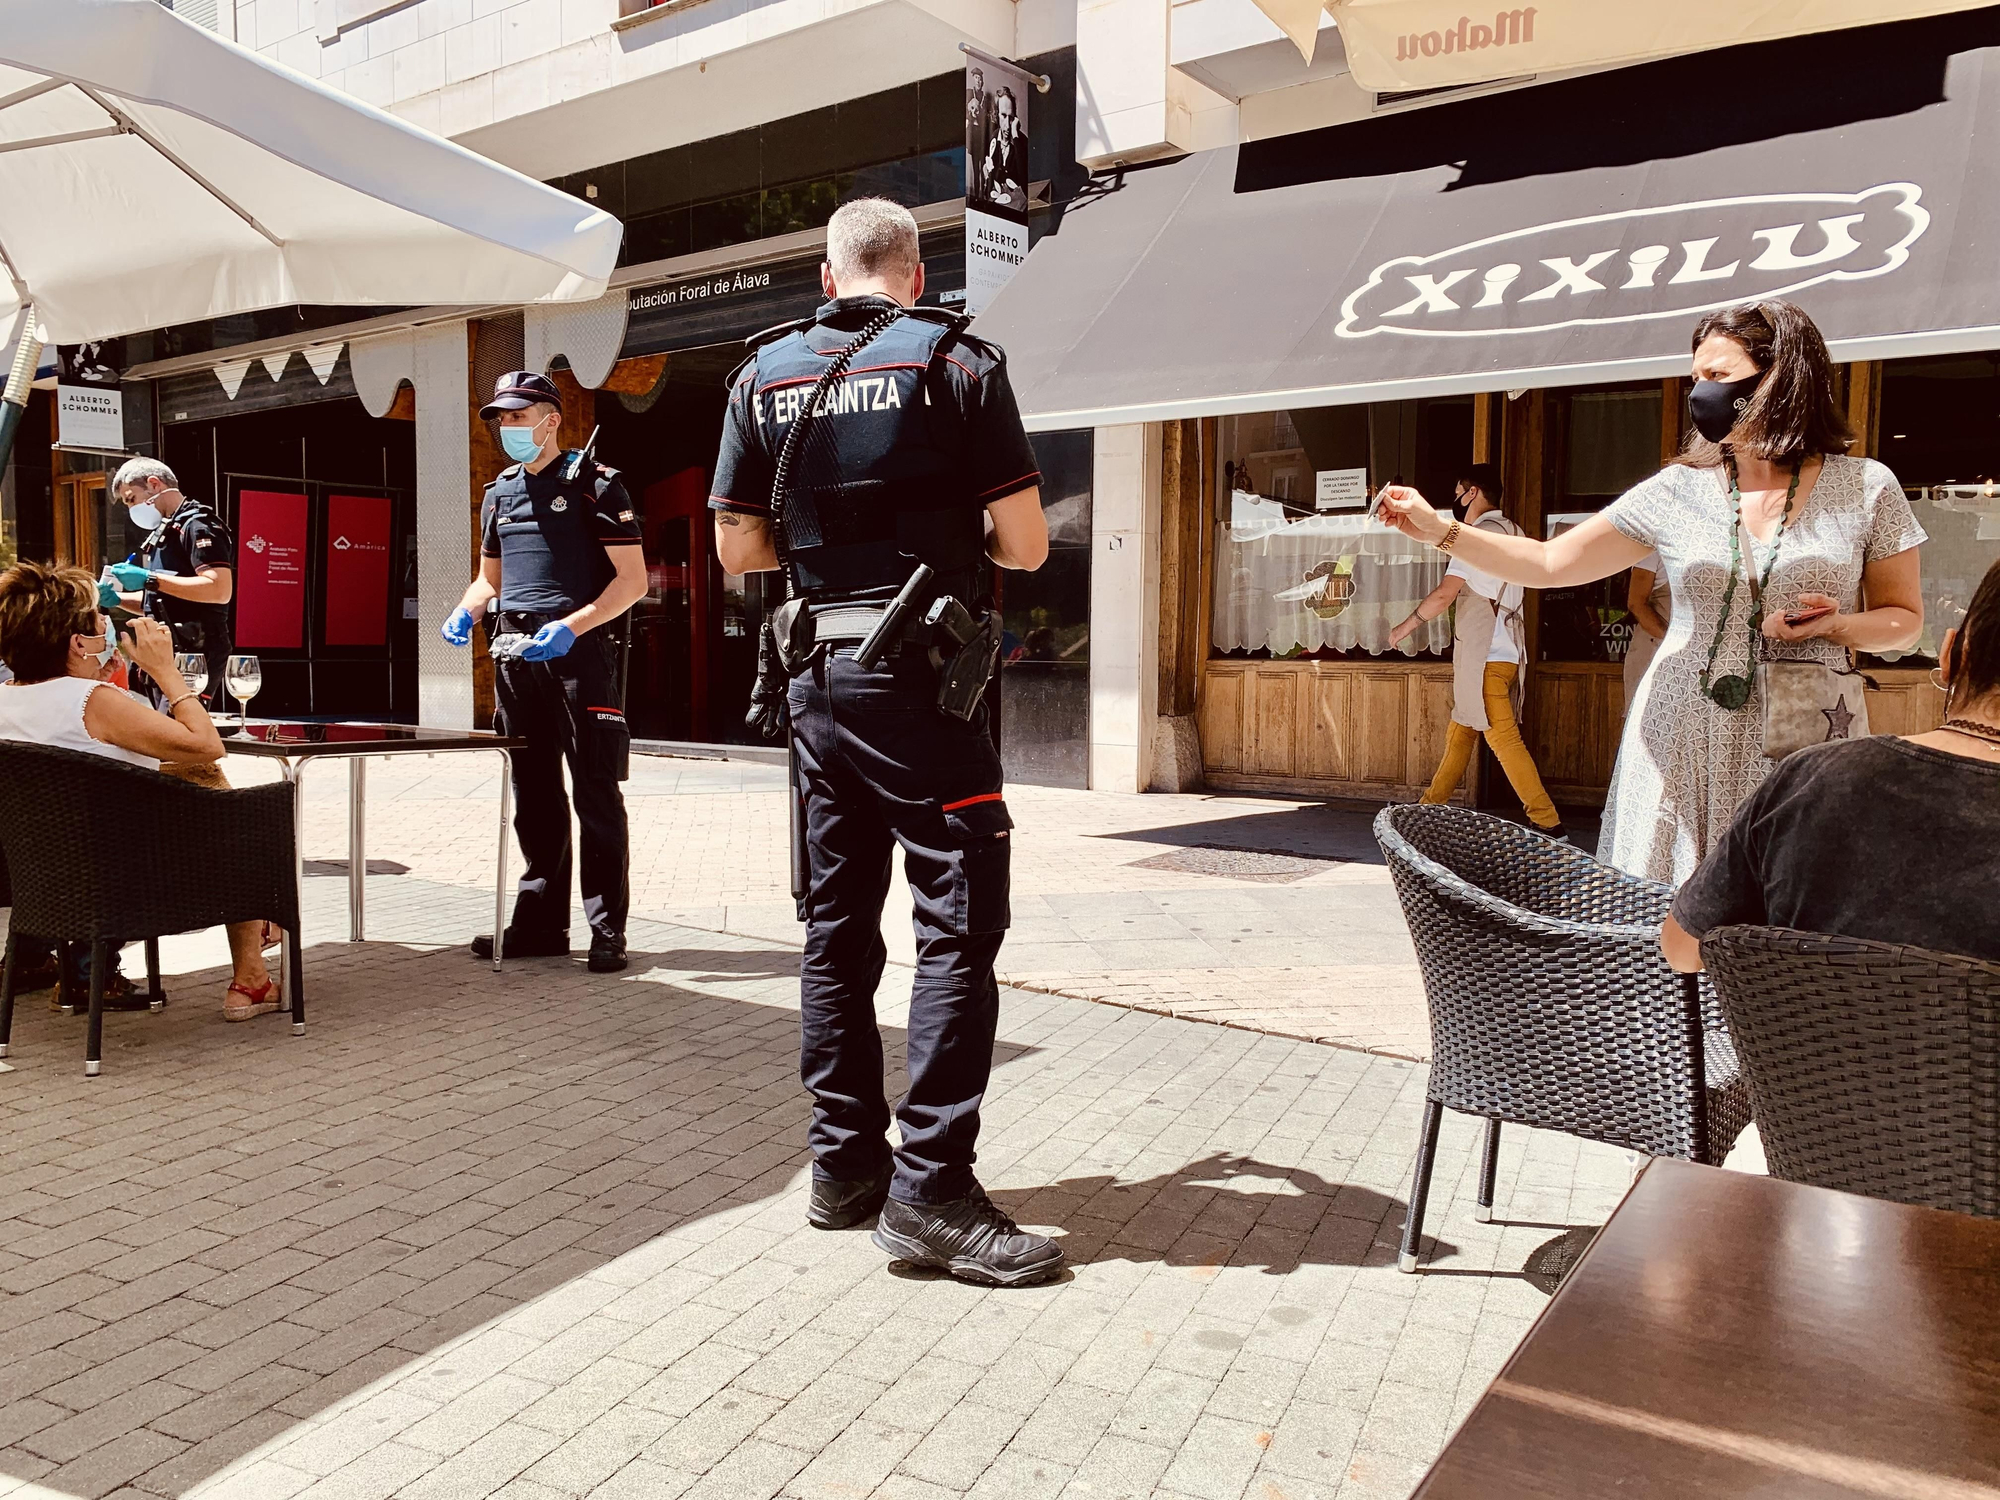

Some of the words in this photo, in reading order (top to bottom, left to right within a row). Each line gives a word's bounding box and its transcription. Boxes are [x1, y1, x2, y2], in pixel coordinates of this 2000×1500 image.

[977, 228, 1018, 249] ALBERTO
[680, 281, 710, 302] Foral
[714, 279, 730, 295] de
[732, 272, 770, 292] Álava
[69, 395, 111, 405] ALBERTO
[775, 376, 901, 424] ERTZAINTZA
[62, 403, 118, 415] SCHOMMER
[1606, 640, 1631, 654] WI
